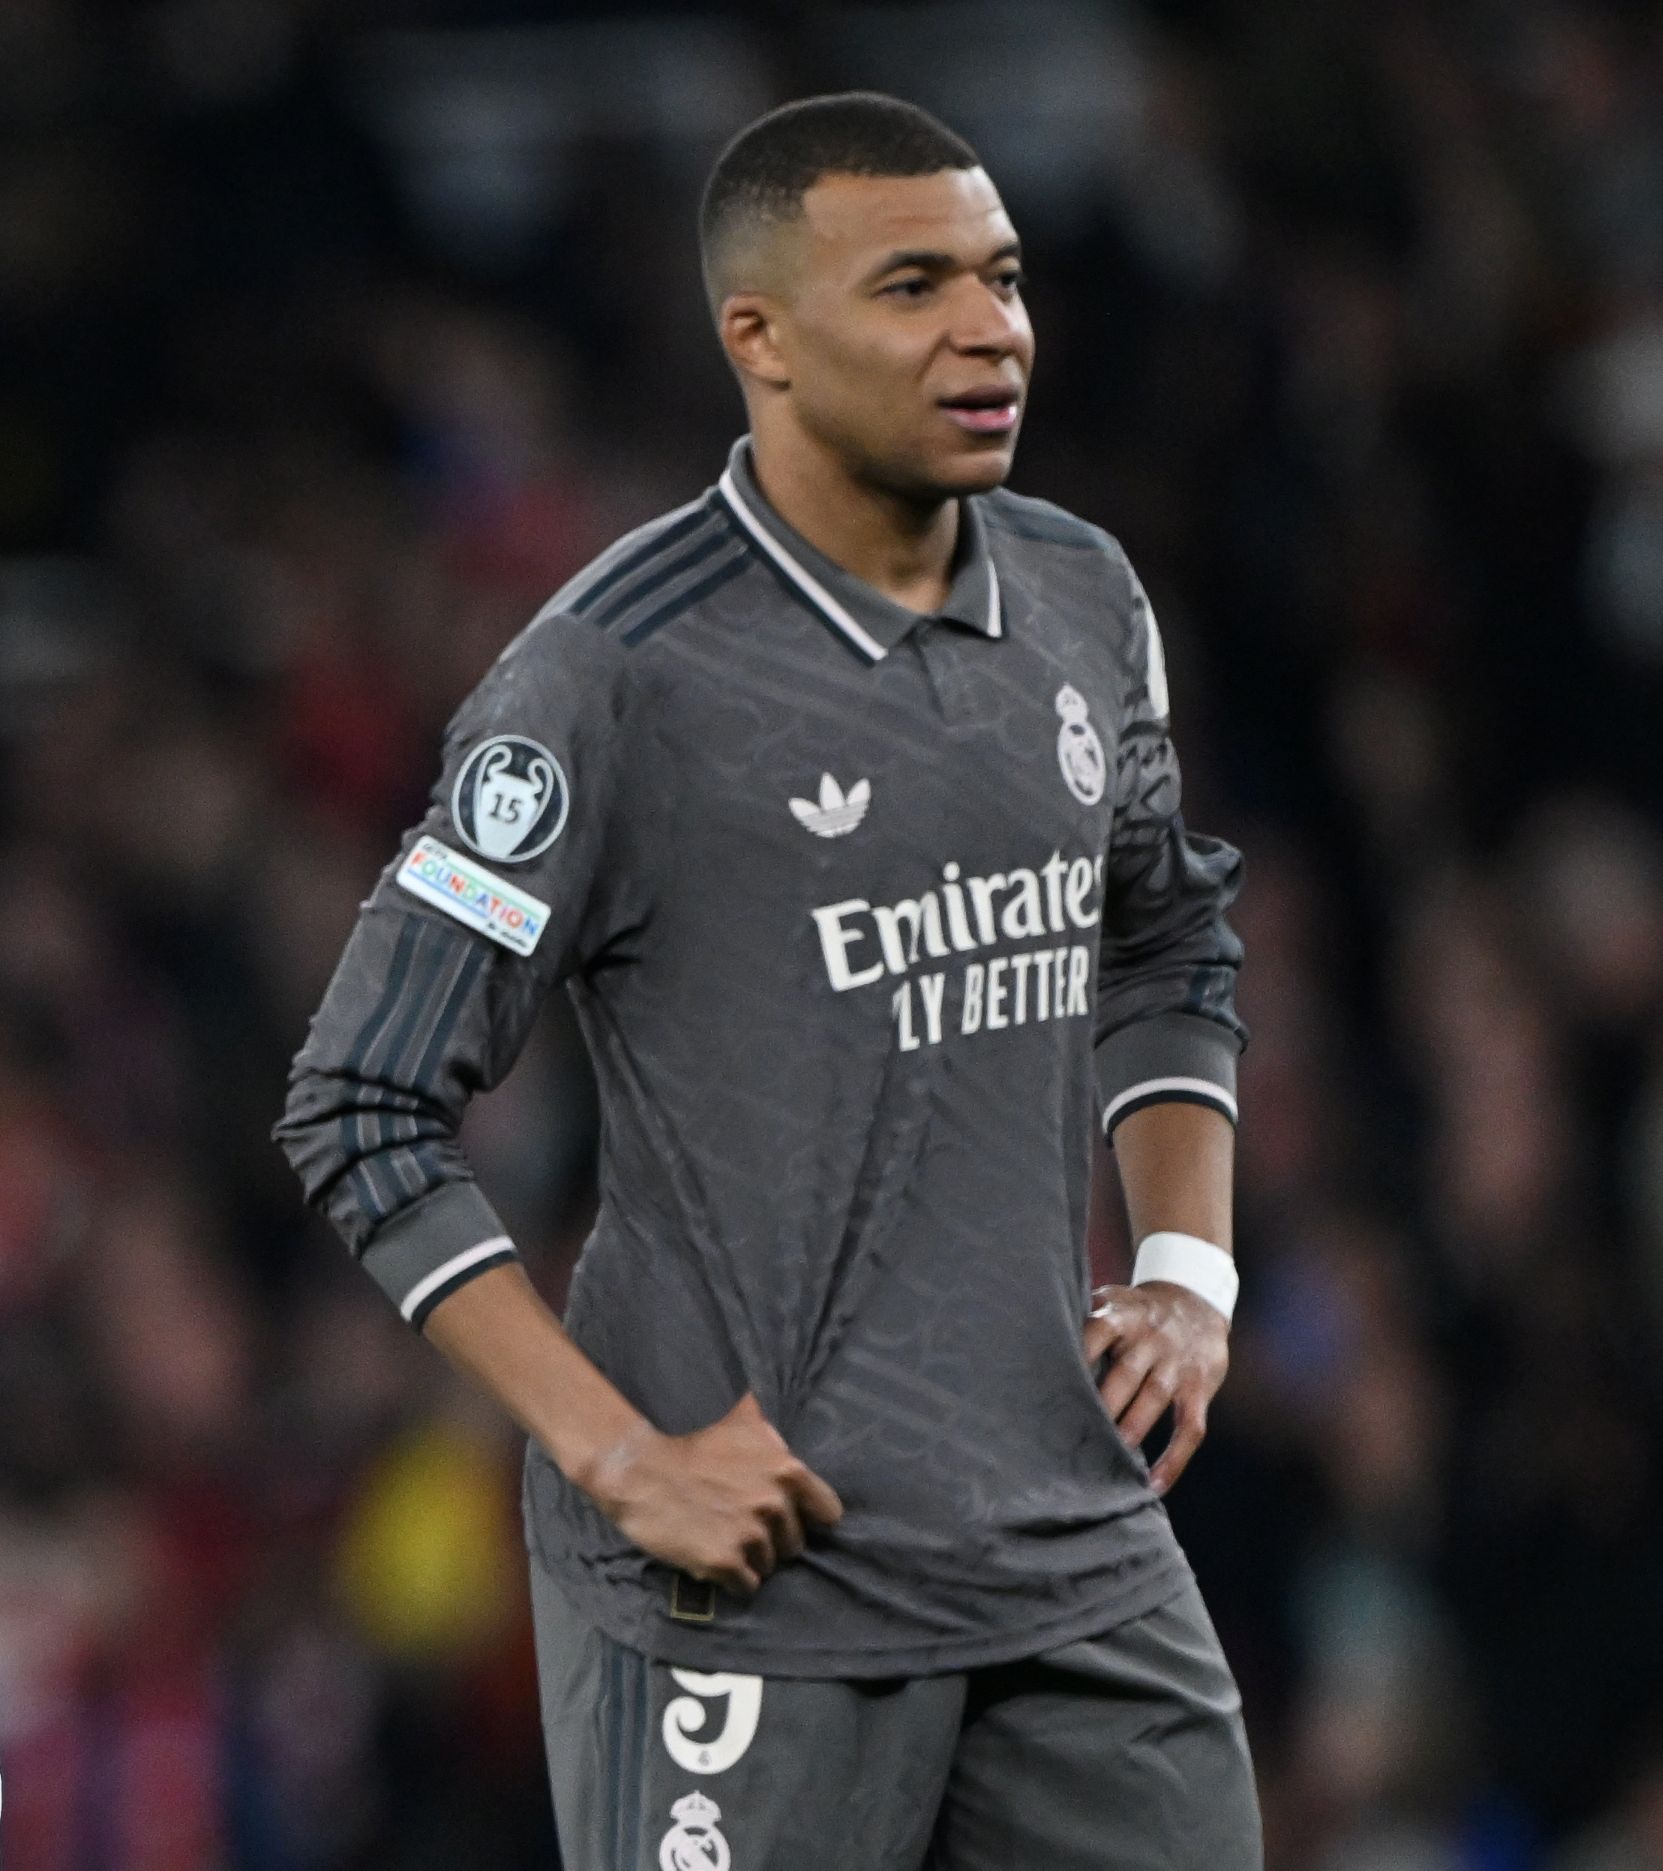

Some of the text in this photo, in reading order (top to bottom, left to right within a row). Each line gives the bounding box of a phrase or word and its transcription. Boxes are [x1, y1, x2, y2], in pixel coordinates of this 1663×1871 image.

[489, 793, 521, 824] 15
[961, 945, 1090, 1036] BETTER
[661, 1667, 764, 1776] 9
